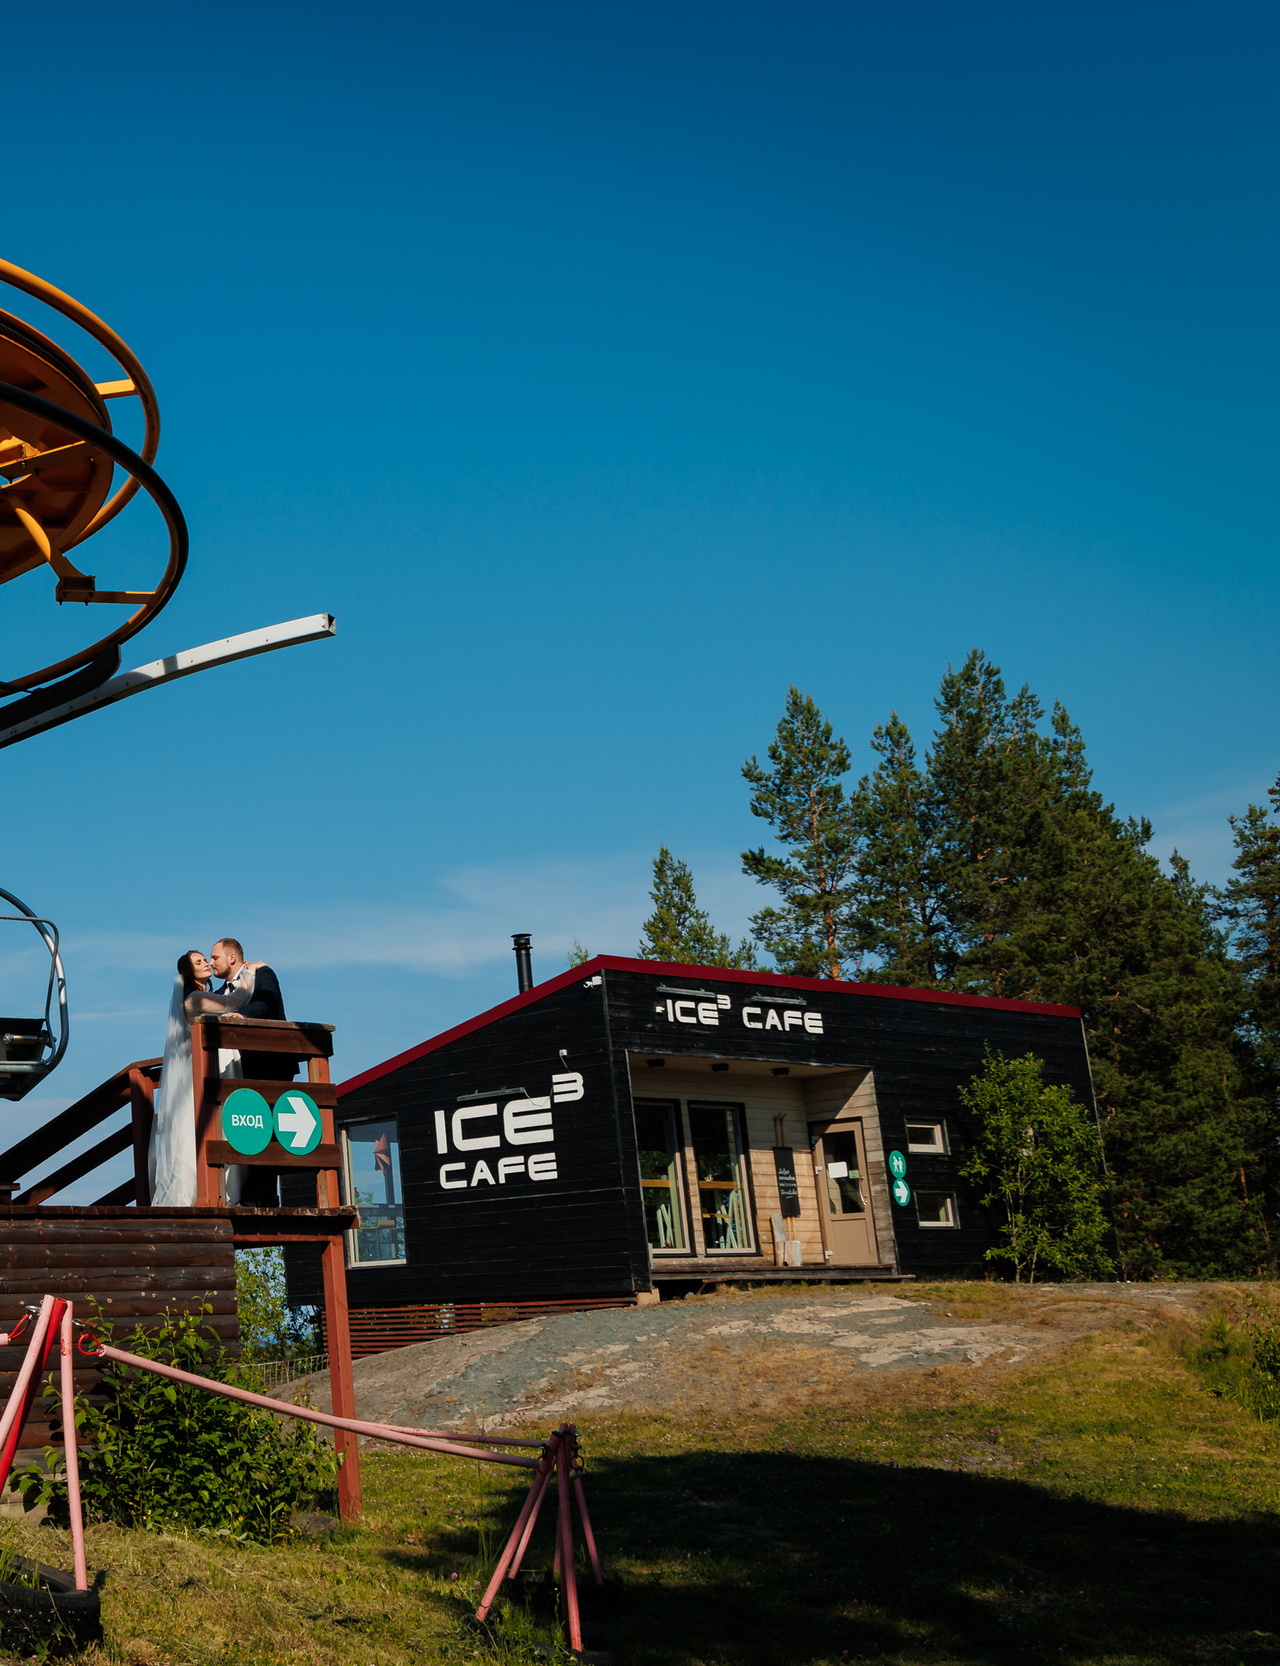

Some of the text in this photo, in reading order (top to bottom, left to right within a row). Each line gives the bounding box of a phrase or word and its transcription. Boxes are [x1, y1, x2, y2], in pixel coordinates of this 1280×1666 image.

[742, 1006, 824, 1035] CAFE
[231, 1114, 264, 1129] ВХОД
[439, 1152, 558, 1190] CAFE
